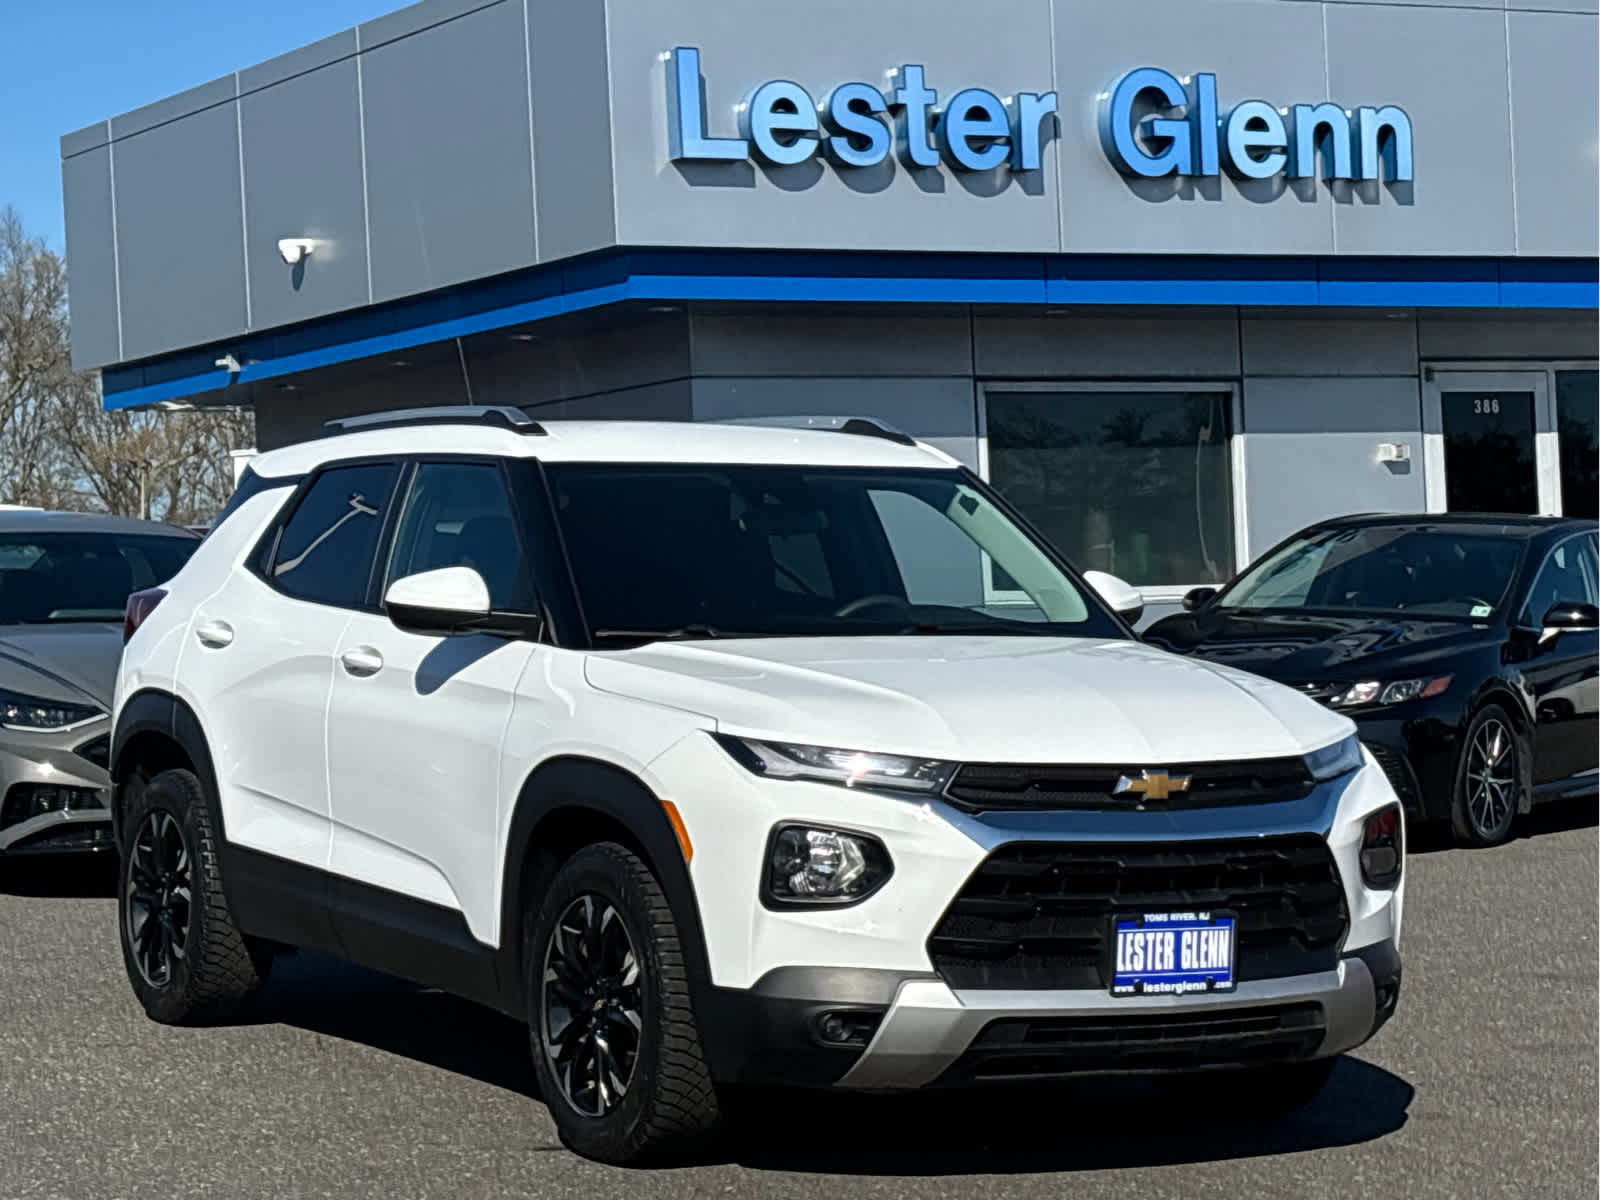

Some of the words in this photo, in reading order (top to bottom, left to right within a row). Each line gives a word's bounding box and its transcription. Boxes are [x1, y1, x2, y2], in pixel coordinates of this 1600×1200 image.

[668, 47, 1057, 171] Lester
[1104, 67, 1414, 182] Glenn
[1474, 399, 1500, 414] 386
[1144, 914, 1168, 922] TOMS
[1199, 912, 1210, 920] NJ
[1117, 932, 1174, 971] LESTER
[1181, 930, 1229, 969] GLENN
